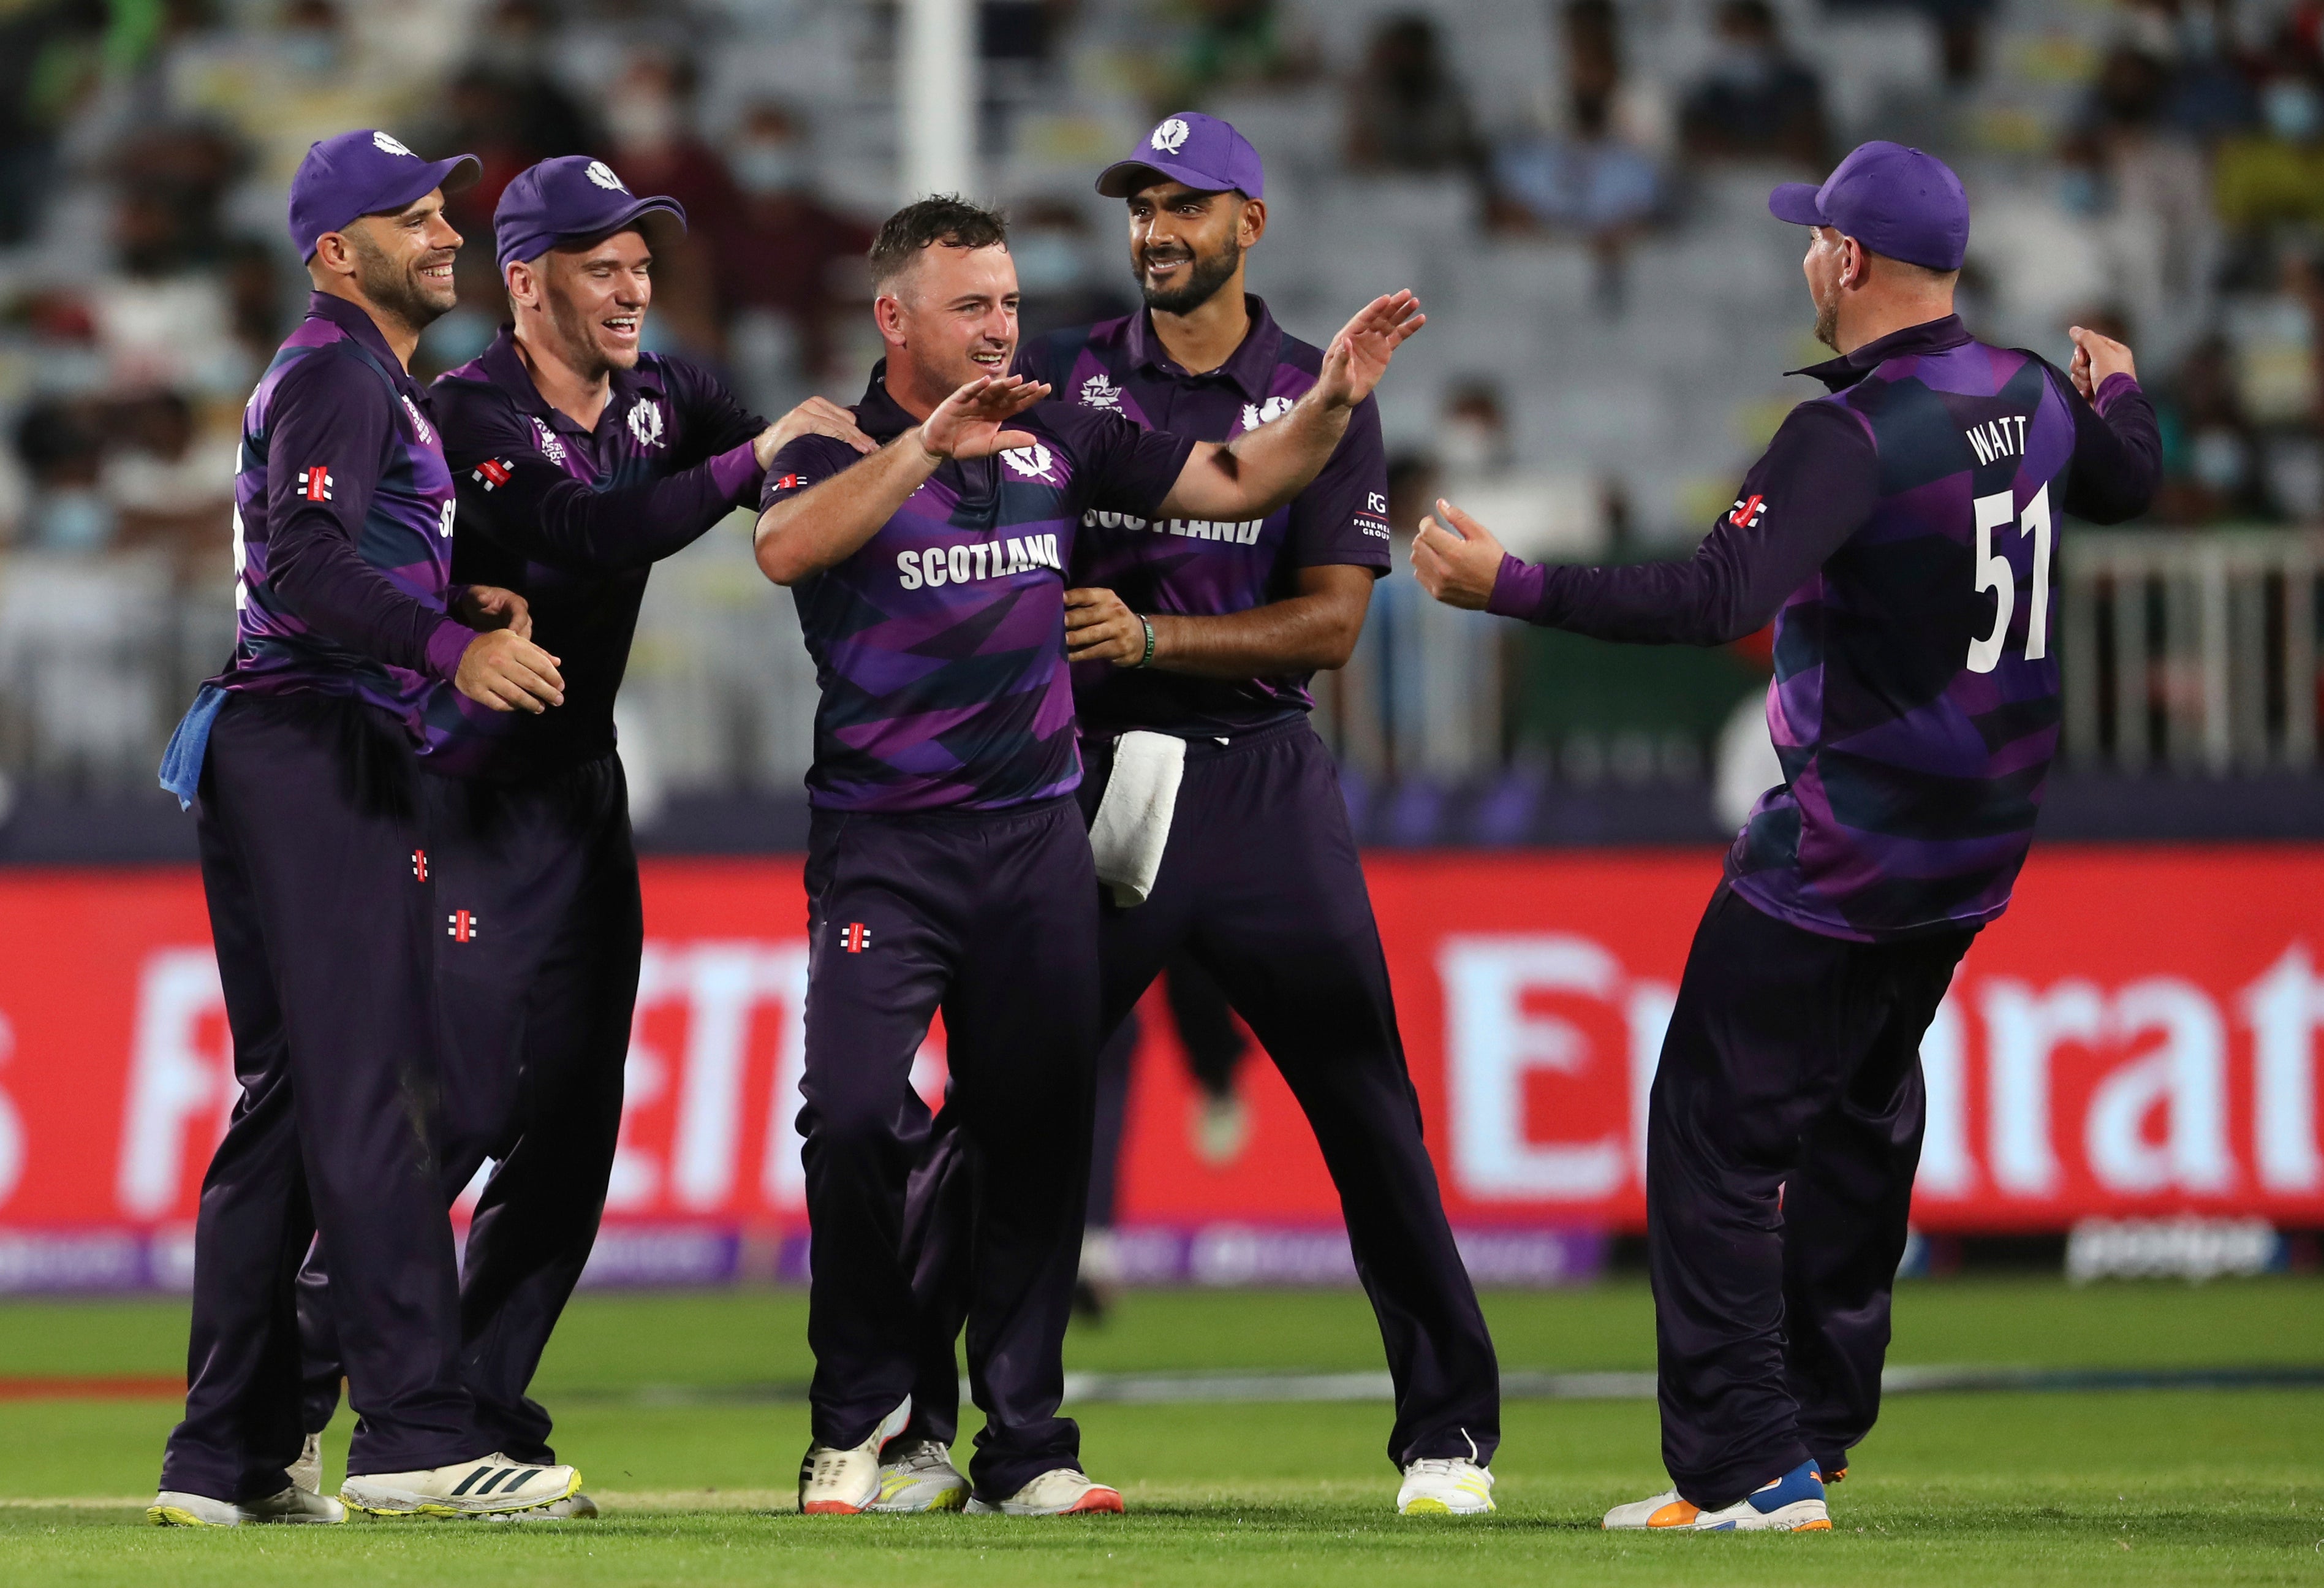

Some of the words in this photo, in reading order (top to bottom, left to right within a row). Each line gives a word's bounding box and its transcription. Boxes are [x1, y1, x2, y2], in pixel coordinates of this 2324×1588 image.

[1966, 416, 2026, 466] WATT
[1353, 519, 1390, 533] PARKMEA
[1363, 528, 1390, 541] GROUP
[897, 534, 1062, 590] SCOTLAND
[1966, 481, 2051, 674] 51
